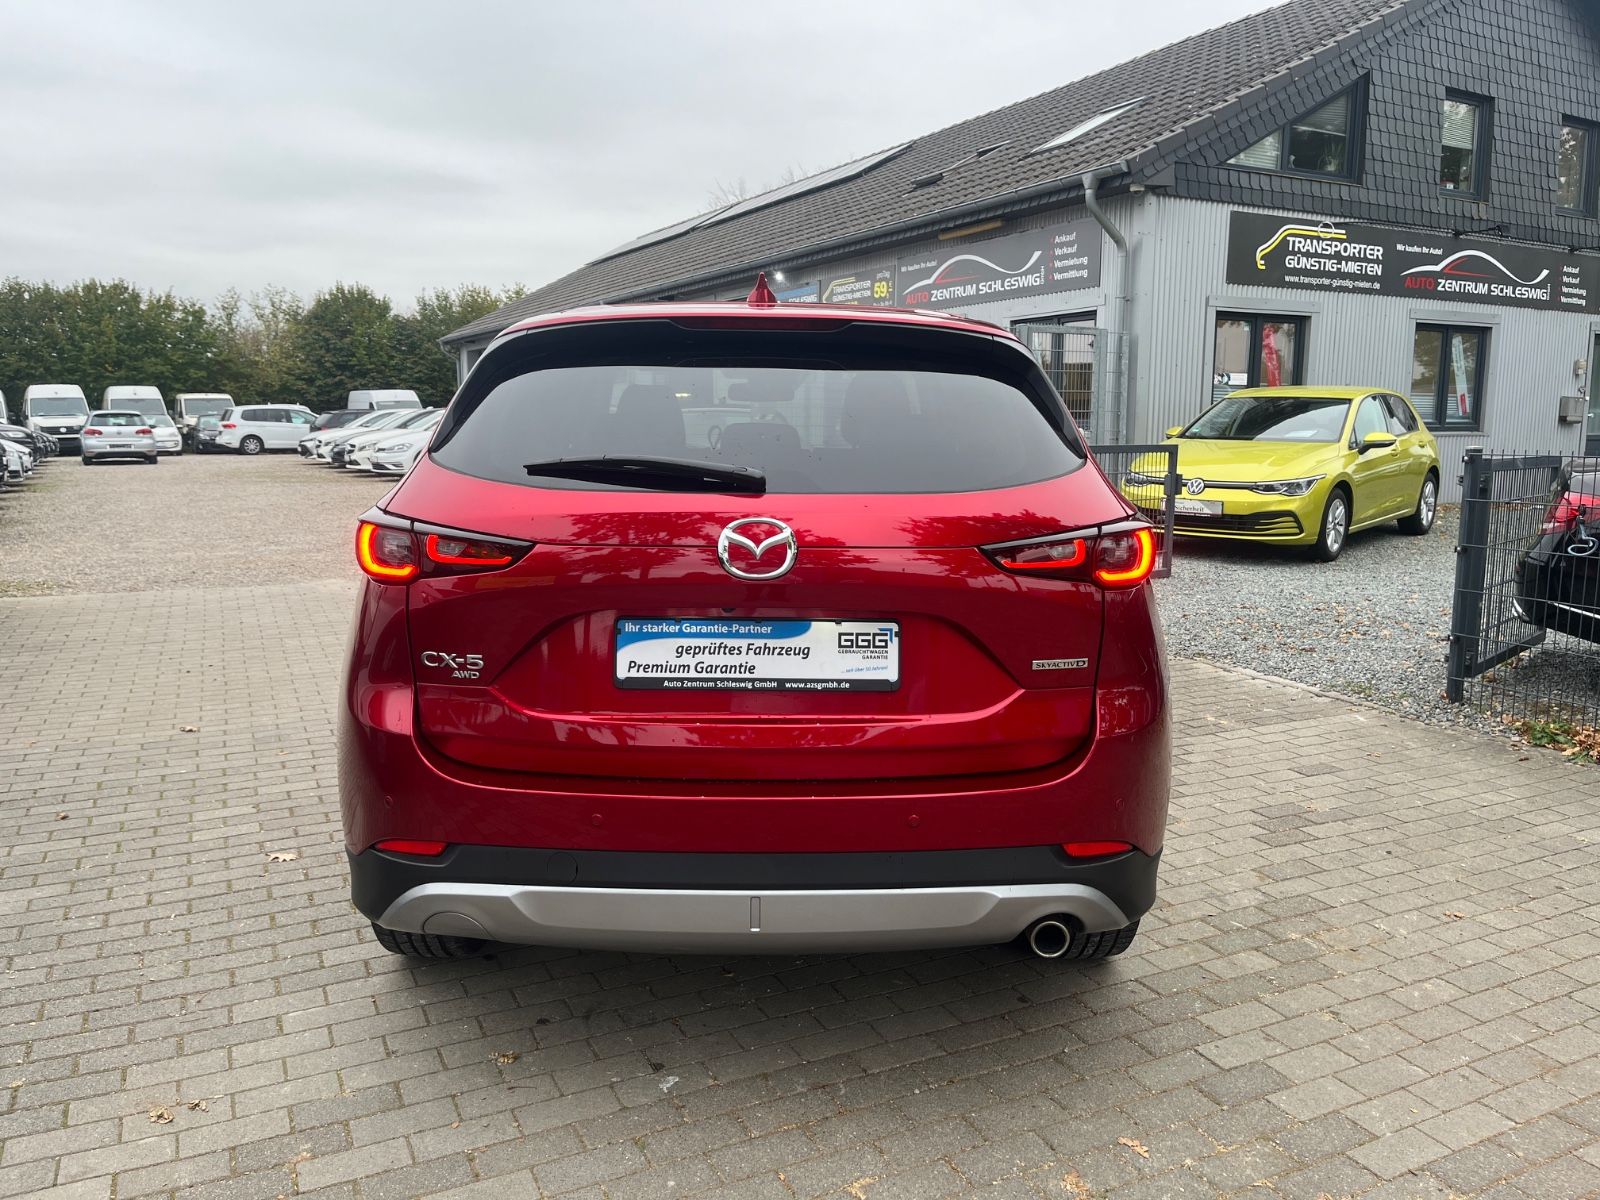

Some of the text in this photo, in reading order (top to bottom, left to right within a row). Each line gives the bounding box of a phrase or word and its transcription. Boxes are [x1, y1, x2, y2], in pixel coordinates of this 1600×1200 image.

[1054, 232, 1076, 243] Ankauf
[1054, 244, 1077, 255] Verkauf
[1286, 236, 1383, 260] TRANSPORTER
[1054, 256, 1088, 268] Vermietung
[1285, 254, 1382, 276] GÜNSTIG-MIETEN
[1054, 269, 1088, 280] Vermittlung
[1563, 266, 1580, 274] Ankauf
[1562, 275, 1580, 284] Verkauf
[906, 274, 1040, 304] AUTO ZENTRUM SCHLESWIG
[1404, 276, 1434, 290] AUTO
[1438, 279, 1488, 295] ZENTRUM
[1490, 284, 1547, 300] SCHLESWIG
[625, 622, 772, 634] Ihr starker Garantie-Partner
[838, 632, 888, 648] GGG
[676, 642, 810, 659] geprüftes Fahrzeug
[421, 651, 484, 670] CX-5
[627, 660, 756, 674] Premium Garantie
[452, 670, 480, 678] AWD
[664, 680, 681, 688] Auto
[683, 680, 714, 688] Zentrum
[716, 680, 752, 690] Schleswig
[785, 681, 850, 690] www.azsgmbh.de
